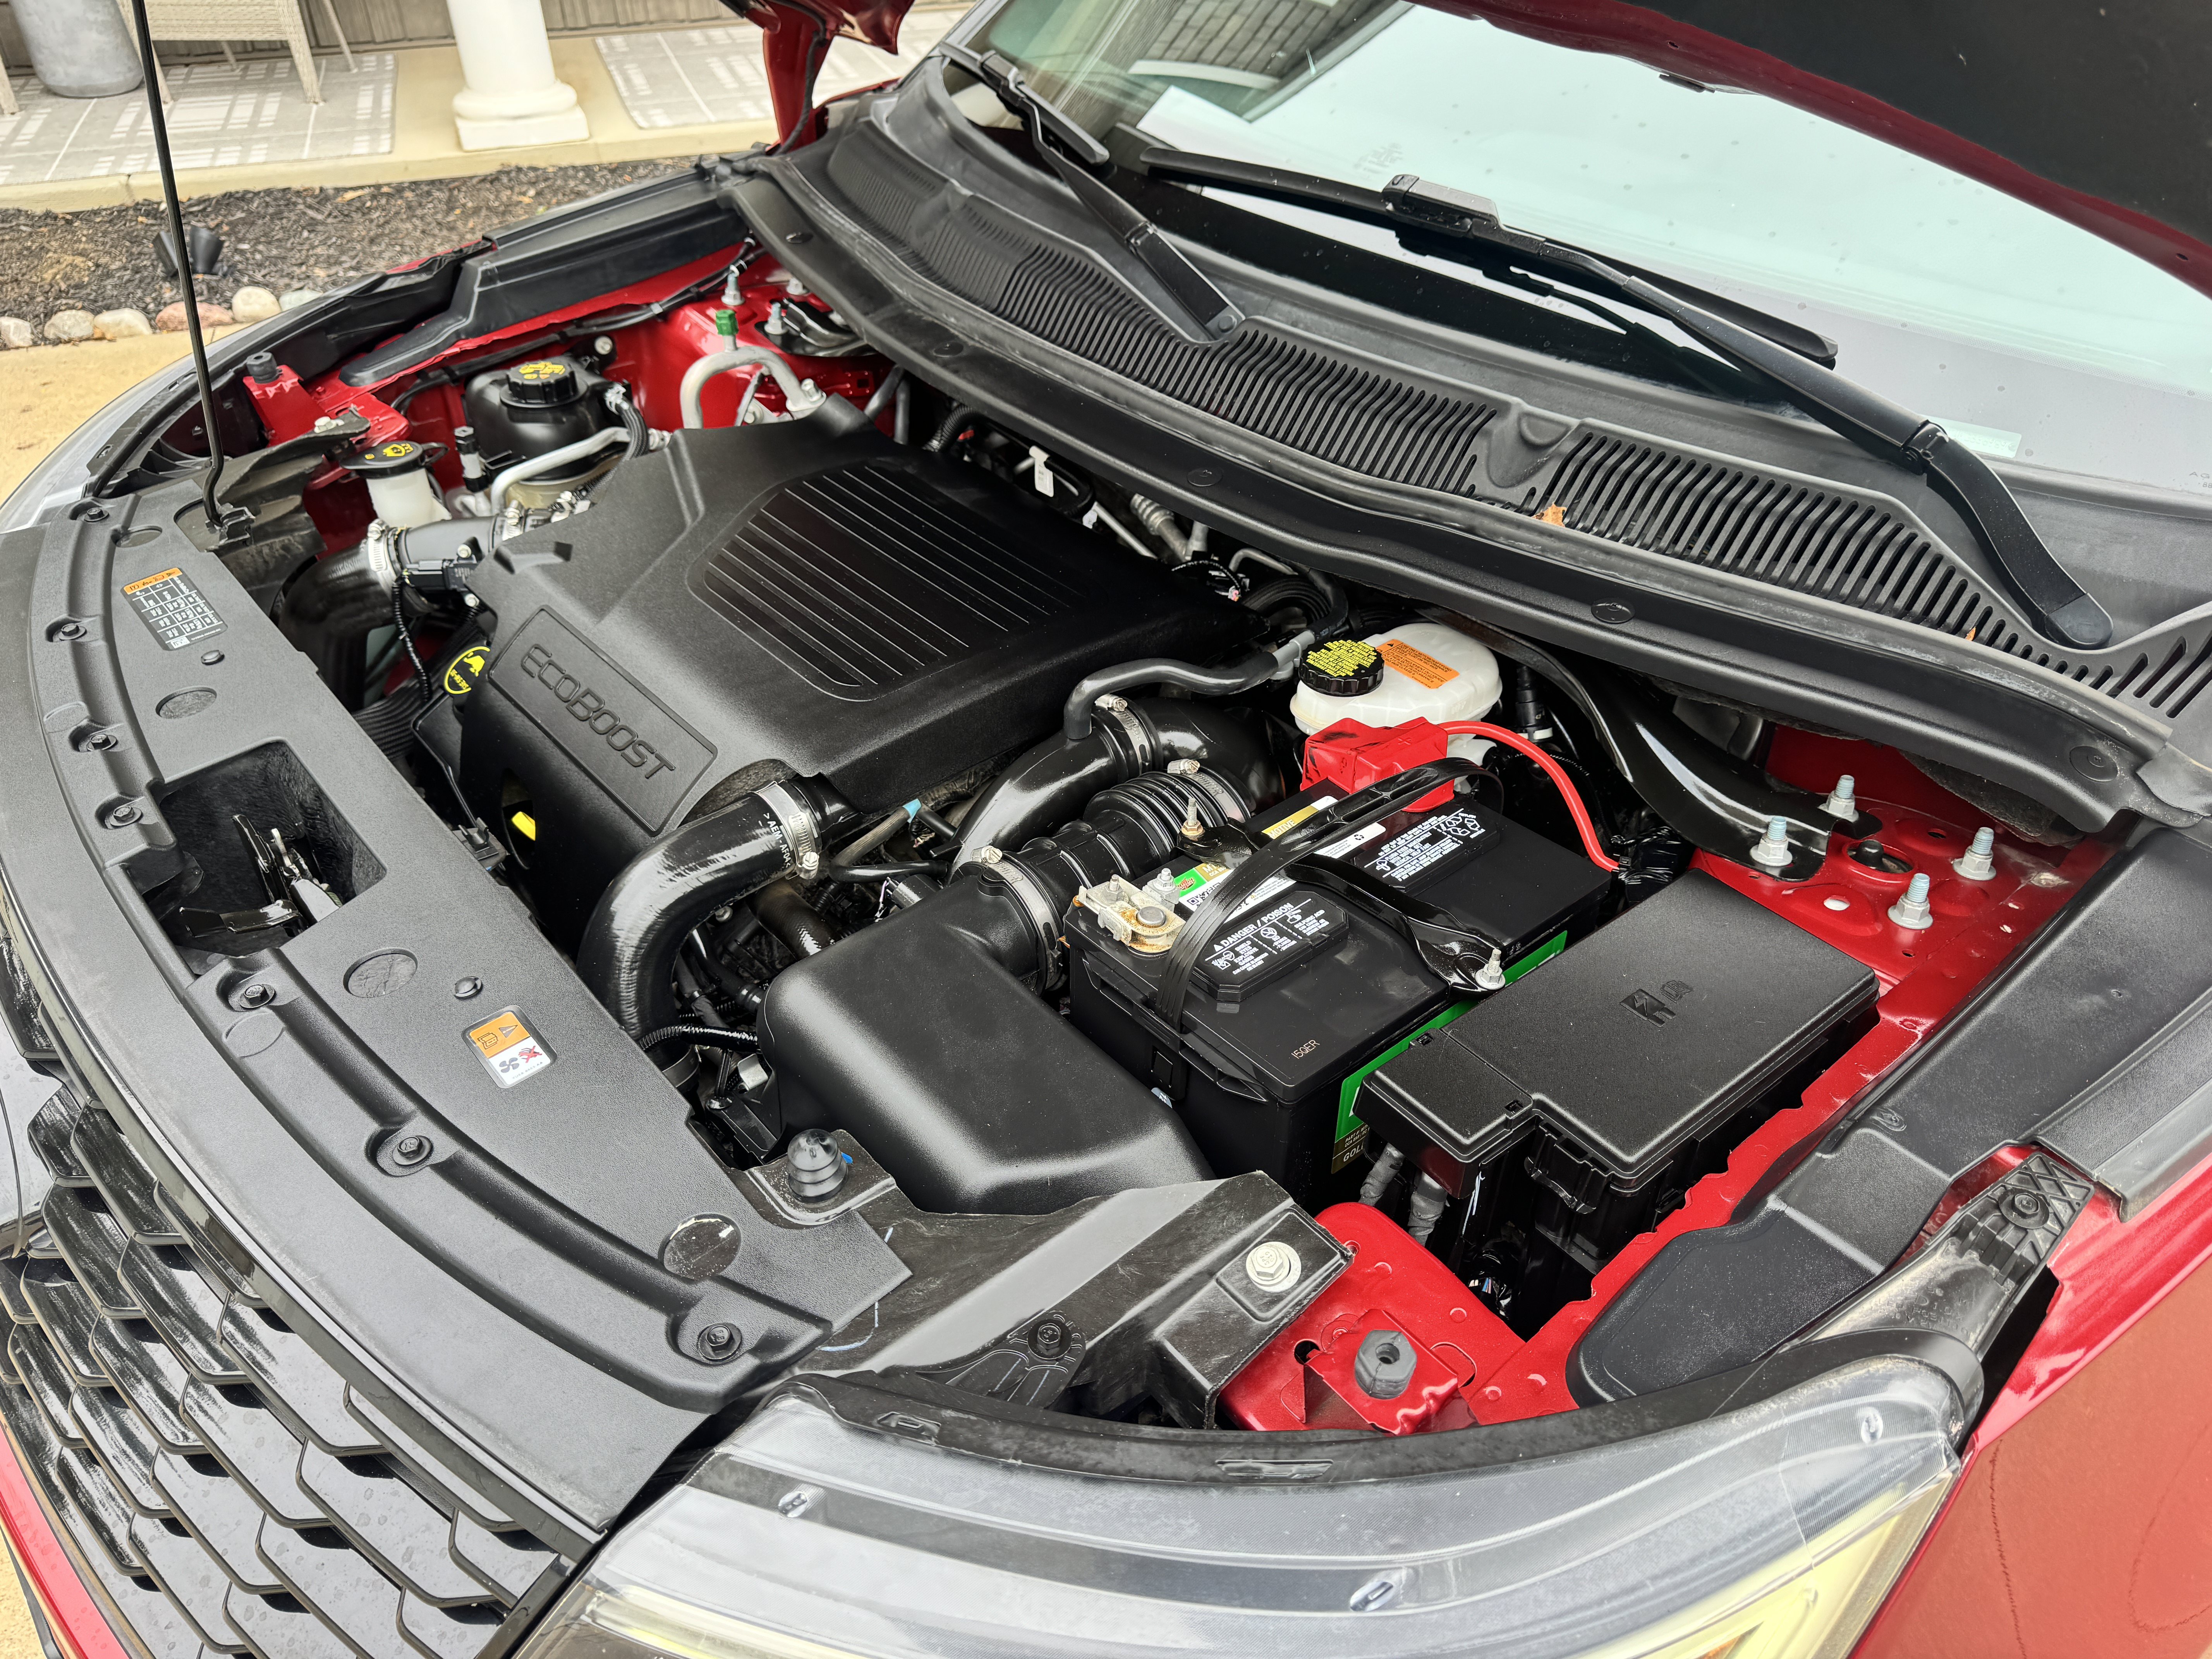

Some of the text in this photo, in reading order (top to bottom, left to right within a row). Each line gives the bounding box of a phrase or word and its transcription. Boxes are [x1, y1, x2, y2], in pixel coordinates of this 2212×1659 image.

[1384, 831, 1432, 861] FLUSH EYES IMMEDIATELY
[1394, 843, 1432, 867] MEDICAL HELP FAST
[1314, 909, 1325, 918] ACID
[1220, 924, 1257, 946] DANGER
[1261, 903, 1294, 923] POISON
[1235, 940, 1252, 951] SHIELD
[1238, 945, 1252, 955] EYES
[1233, 947, 1259, 963] EXPLOSIVE
[1238, 955, 1255, 966] GASES
[1343, 1142, 1364, 1162] GOL
